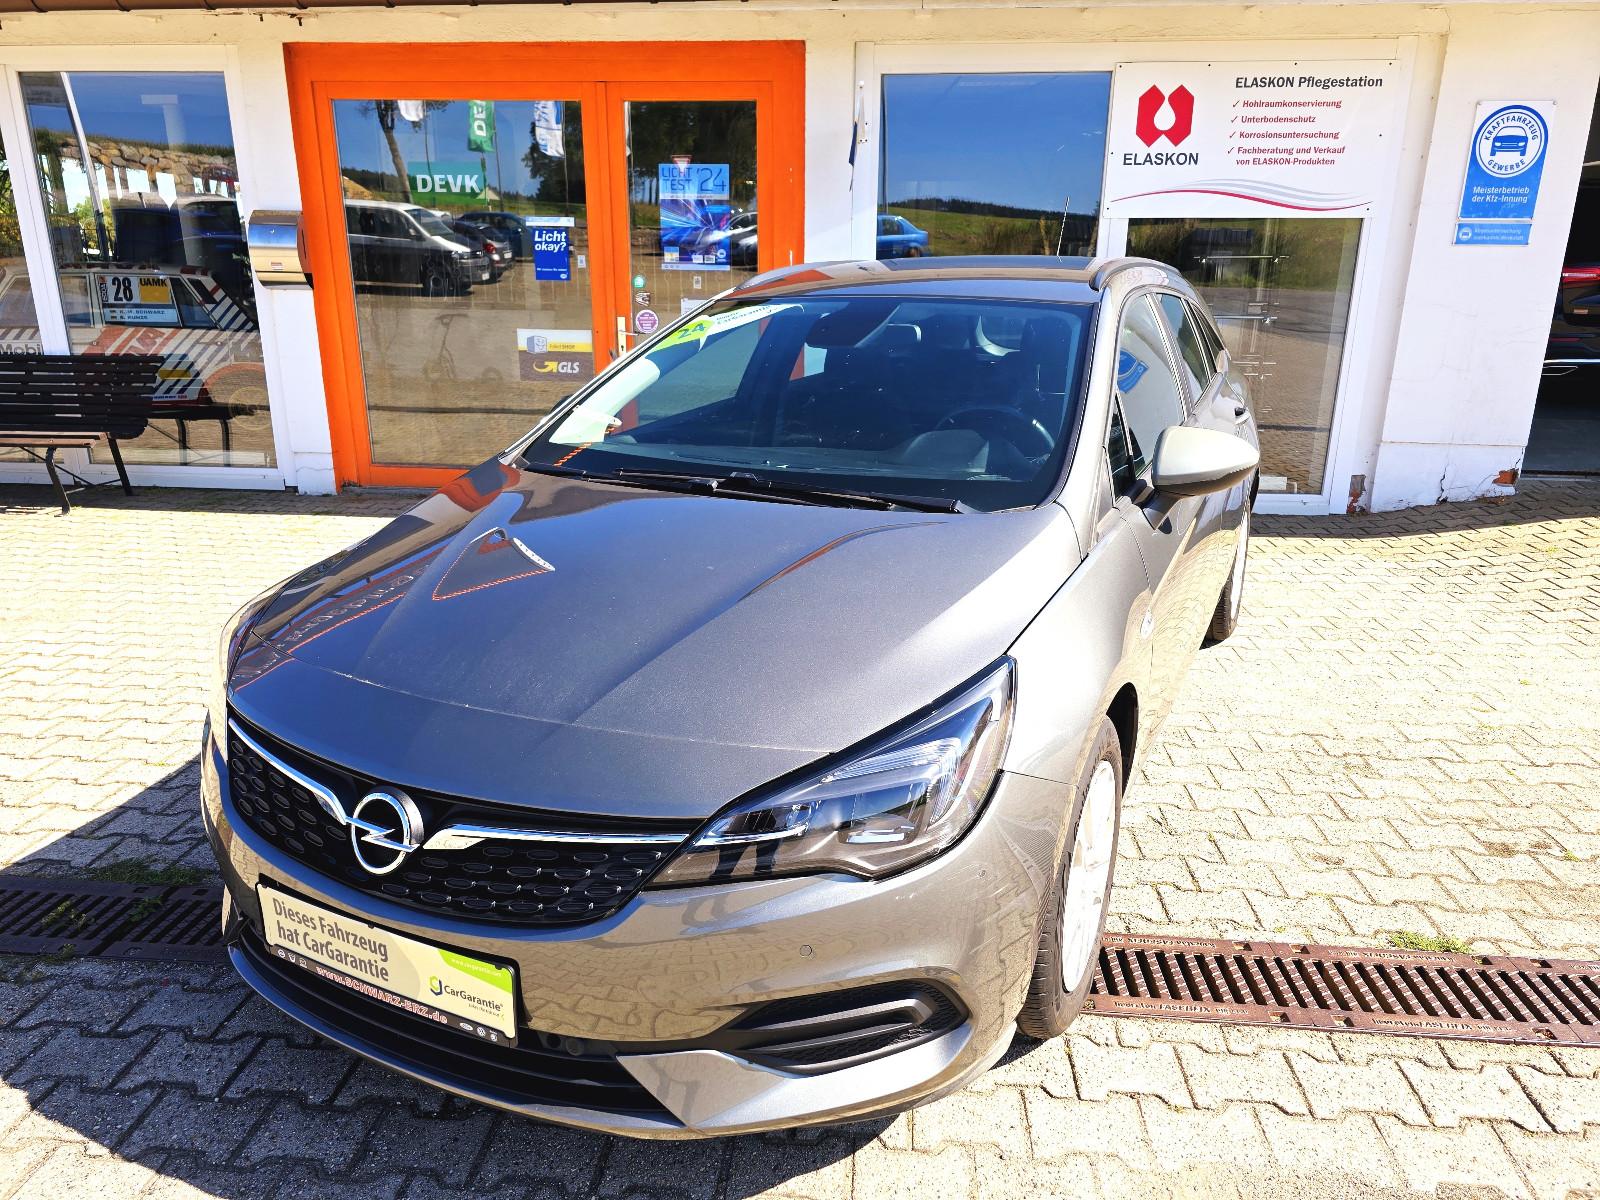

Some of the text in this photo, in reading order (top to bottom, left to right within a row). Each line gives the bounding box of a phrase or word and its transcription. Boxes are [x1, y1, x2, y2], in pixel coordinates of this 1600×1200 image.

[1235, 75, 1383, 90] ELASKON Pflegestation
[1242, 99, 1342, 109] Hohlraumkonservierung
[1240, 115, 1316, 124] Unterbodenschutz
[1483, 115, 1539, 141] KRAFTFAHRZEUG
[1239, 130, 1340, 140] Korrosionsuntersuchung
[1237, 145, 1345, 156] Fachberatung und Verkauf
[1122, 152, 1199, 166] ELASKON
[1236, 157, 1335, 166] von ELASKON-Produkten
[1487, 158, 1526, 172] GEWERBE
[661, 167, 693, 178] LICHT
[416, 174, 482, 193] DEVK
[662, 178, 693, 191] TEST
[1473, 186, 1530, 194] Meisterbetrieb
[1472, 195, 1528, 204] der Kfz-Innung
[534, 230, 567, 242] Licht
[534, 241, 567, 253] okay?
[111, 276, 134, 302] 28
[677, 323, 707, 339] 24
[557, 361, 580, 374] GLS
[272, 897, 389, 962] Dieses Fahrzeug
[276, 919, 389, 982] hat CarGarantie
[444, 985, 502, 1011] CarGarantie
